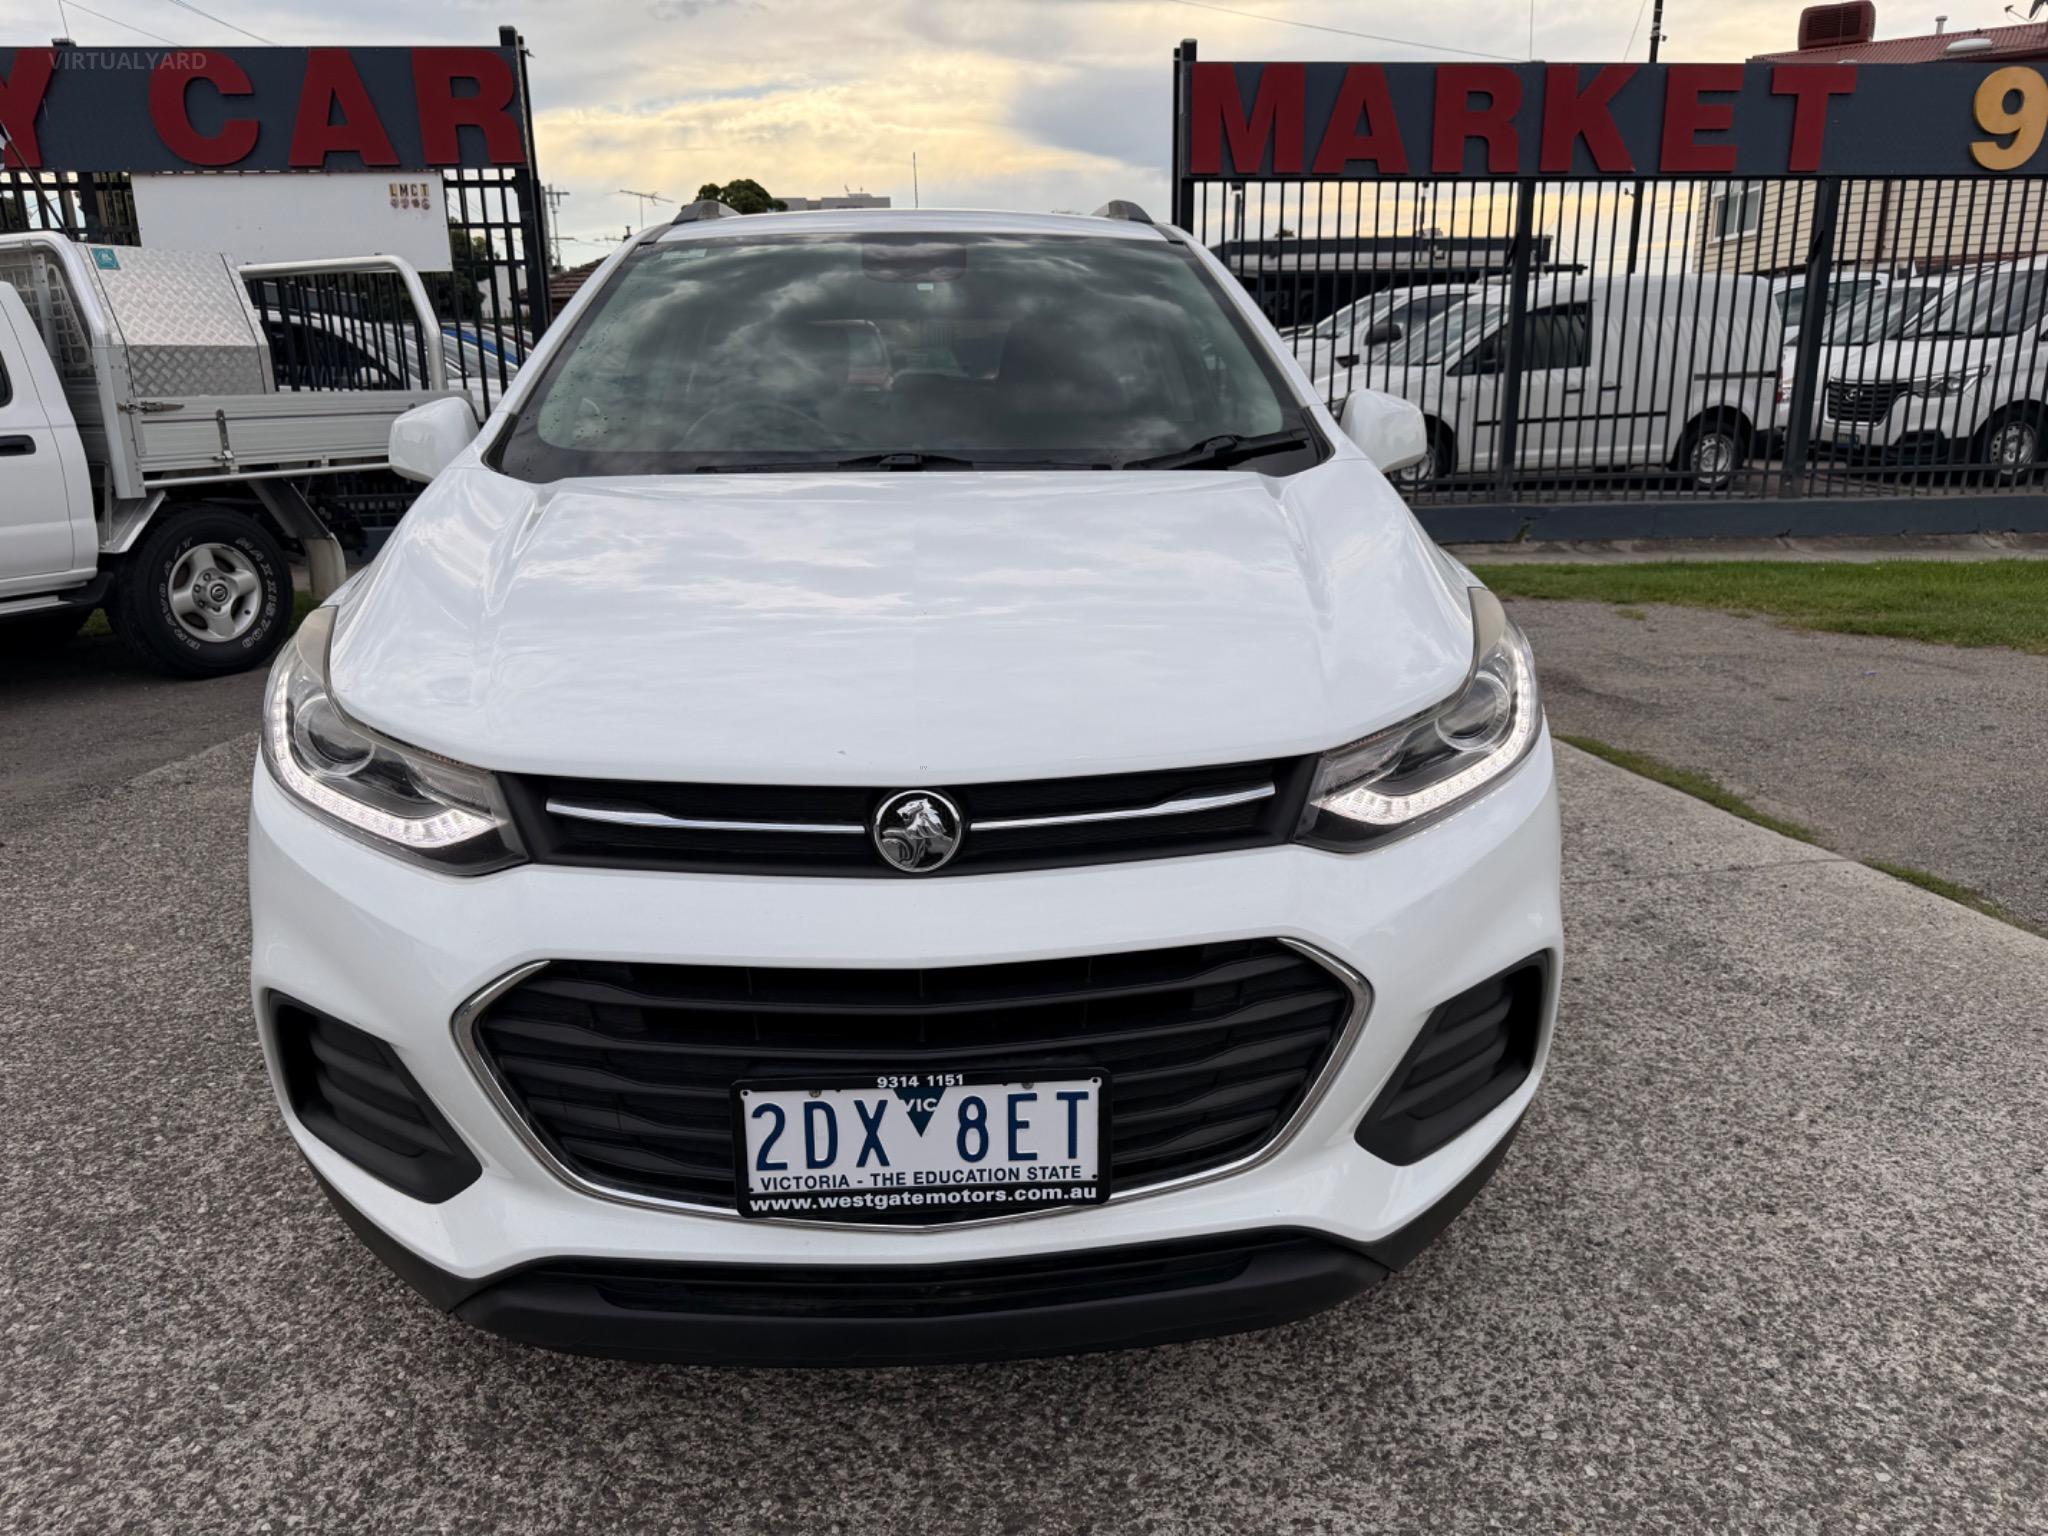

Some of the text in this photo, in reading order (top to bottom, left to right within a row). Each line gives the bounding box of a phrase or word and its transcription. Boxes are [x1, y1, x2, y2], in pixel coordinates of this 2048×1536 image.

[147, 48, 527, 167] CAR
[1190, 63, 1858, 175] MARKET
[389, 183, 429, 197] LMCT
[877, 1074, 963, 1088] 9314 1151
[903, 1098, 938, 1112] VIC
[751, 1091, 1089, 1171] 2DX 8ET
[760, 1174, 850, 1190] VICTORIA
[870, 1172, 906, 1186] THE
[913, 1168, 1020, 1185] EDUCATION
[1026, 1166, 1081, 1180] STATE
[750, 1187, 1097, 1211] www.westgatemotors.com.au
